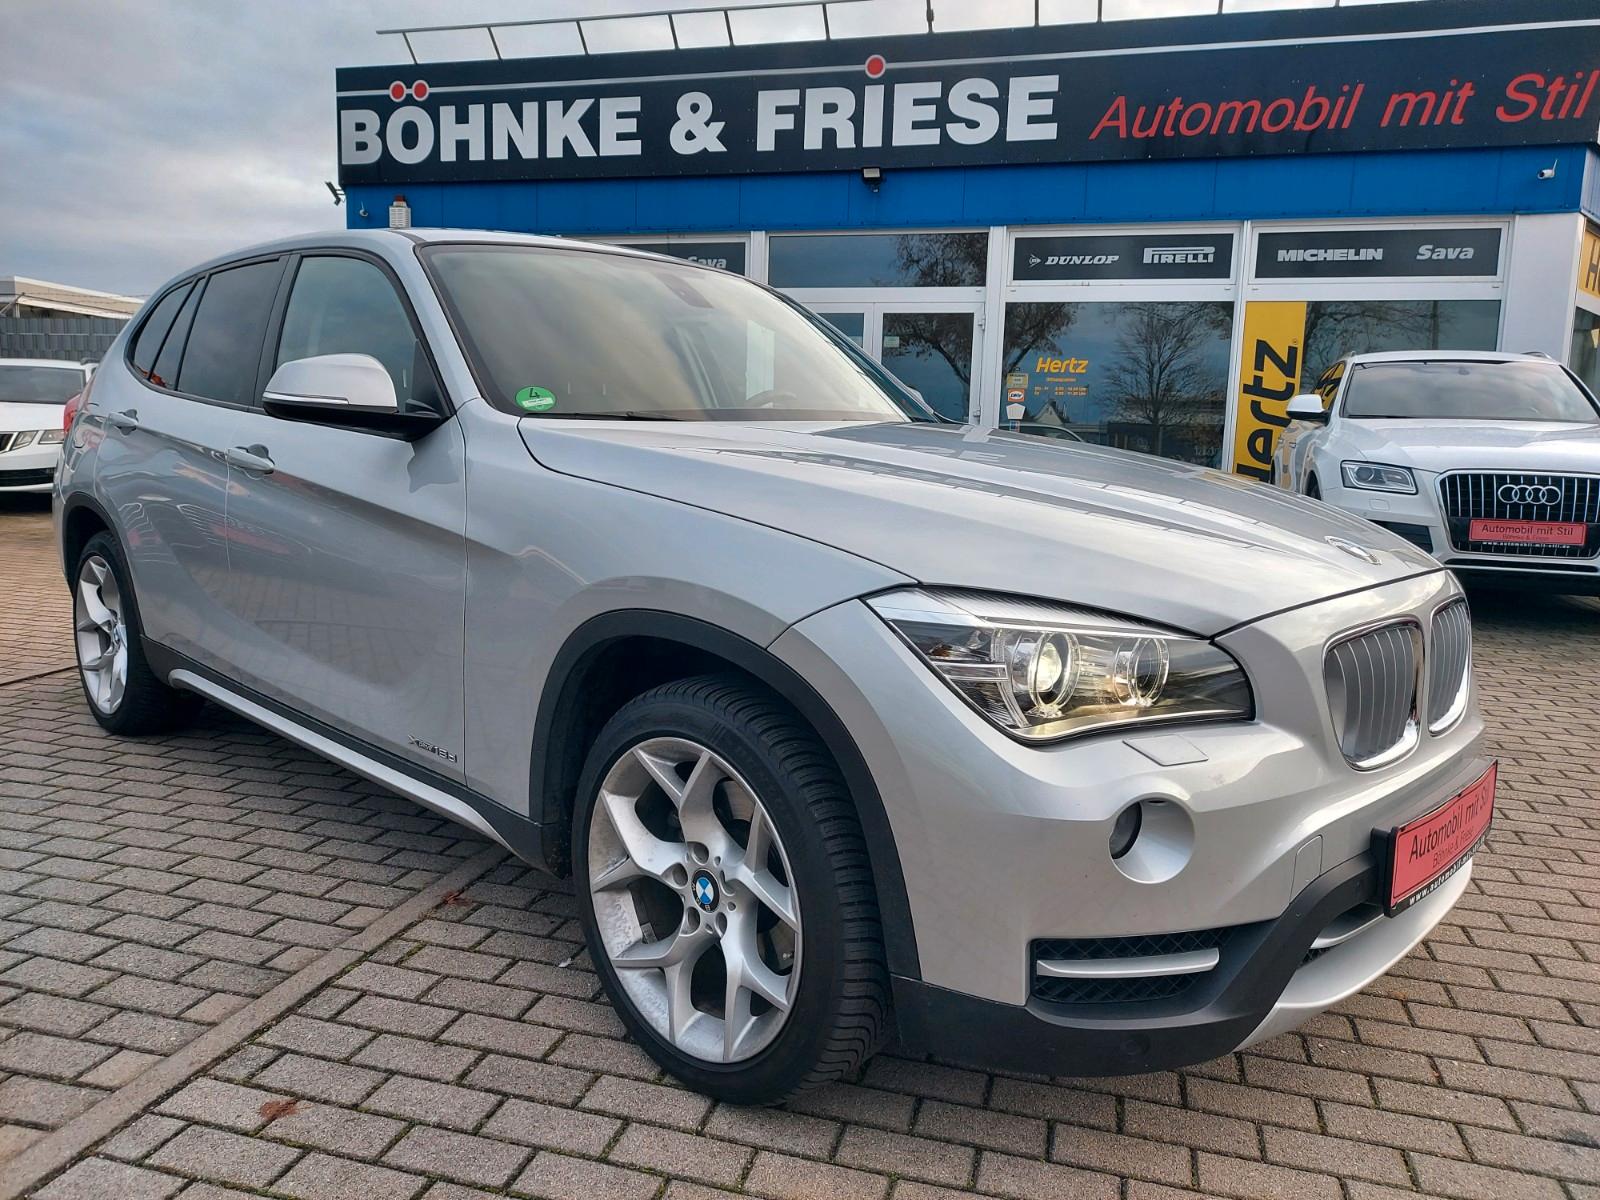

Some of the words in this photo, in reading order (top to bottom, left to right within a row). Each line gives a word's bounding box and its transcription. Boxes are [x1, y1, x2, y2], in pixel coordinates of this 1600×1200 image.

[339, 79, 642, 165] BÖHNKE
[668, 91, 728, 155] &
[755, 54, 1060, 151] FRIESE
[1089, 84, 1364, 140] Automobil
[1380, 78, 1475, 127] mit
[1496, 70, 1600, 124] Stil
[1045, 255, 1120, 265] DUNLOP
[1142, 246, 1215, 264] PIRELLI
[1277, 248, 1384, 262] MICHELIN
[1416, 244, 1475, 260] Sava
[1035, 357, 1089, 374] Hertz
[1481, 524, 1533, 535] Automobil
[1536, 526, 1553, 535] mit
[1557, 527, 1574, 536] Stil
[1408, 803, 1464, 865] Automobil
